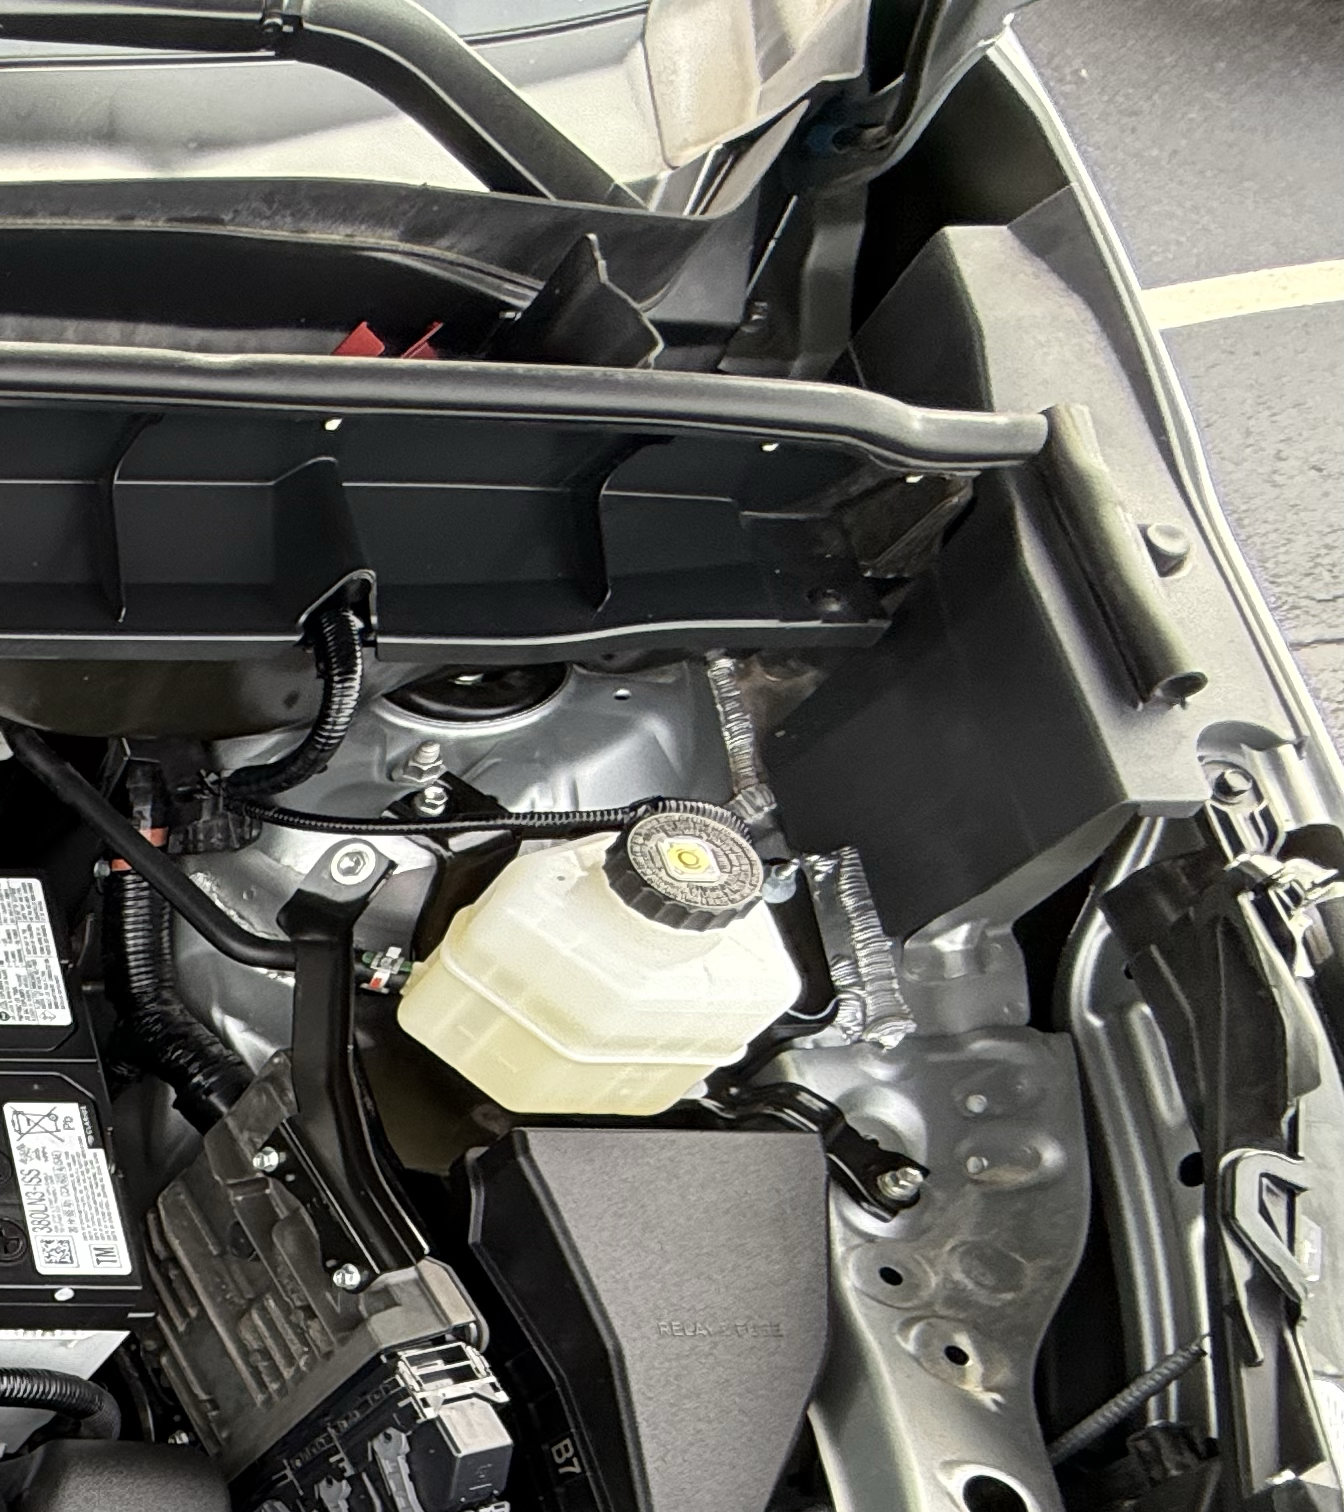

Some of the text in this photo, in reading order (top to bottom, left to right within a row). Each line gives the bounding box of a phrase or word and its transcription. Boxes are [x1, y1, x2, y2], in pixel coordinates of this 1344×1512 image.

[20, 1168, 53, 1233] 380LN3-ISS
[92, 1246, 117, 1266] TM
[550, 1438, 582, 1476] B7
